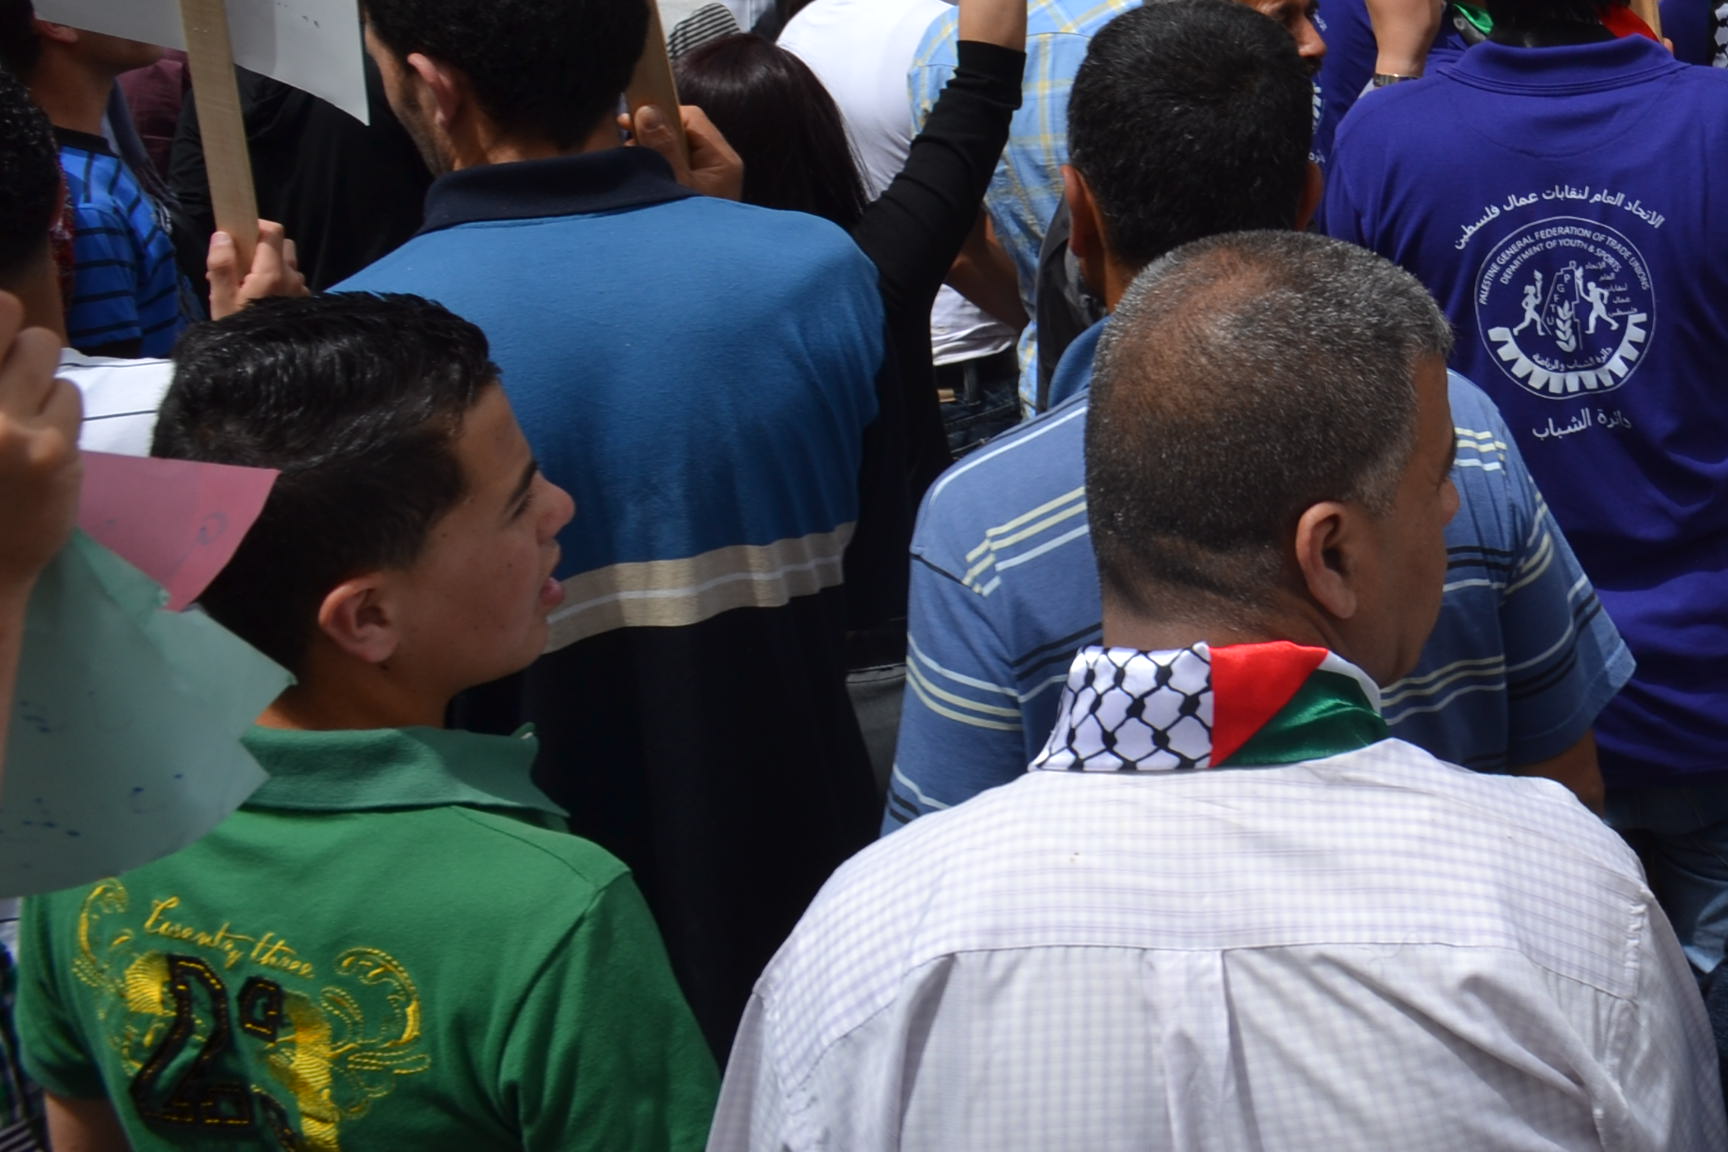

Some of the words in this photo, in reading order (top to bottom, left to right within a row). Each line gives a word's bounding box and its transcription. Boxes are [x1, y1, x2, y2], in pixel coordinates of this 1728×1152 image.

[1502, 192, 1539, 211] عمال
[1541, 184, 1590, 201] لنقابات
[1589, 189, 1625, 208] العام
[1454, 204, 1501, 250] فلسطين
[1624, 199, 1666, 229] الاتحاد
[1478, 262, 1501, 305] PALESTINE
[1496, 235, 1535, 265] GENERAL
[1534, 226, 1592, 241] FEDERATION
[1591, 232, 1606, 243] OF
[1604, 236, 1633, 260] TRADE
[1627, 252, 1651, 291] UNIONS
[1499, 243, 1545, 286] DEPARTMENT
[1545, 239, 1557, 250] OF
[1558, 238, 1589, 249] YOUTH
[1595, 247, 1622, 274] SPORTS
[1531, 407, 1593, 441] الشباب
[1597, 408, 1633, 430] دائرة
